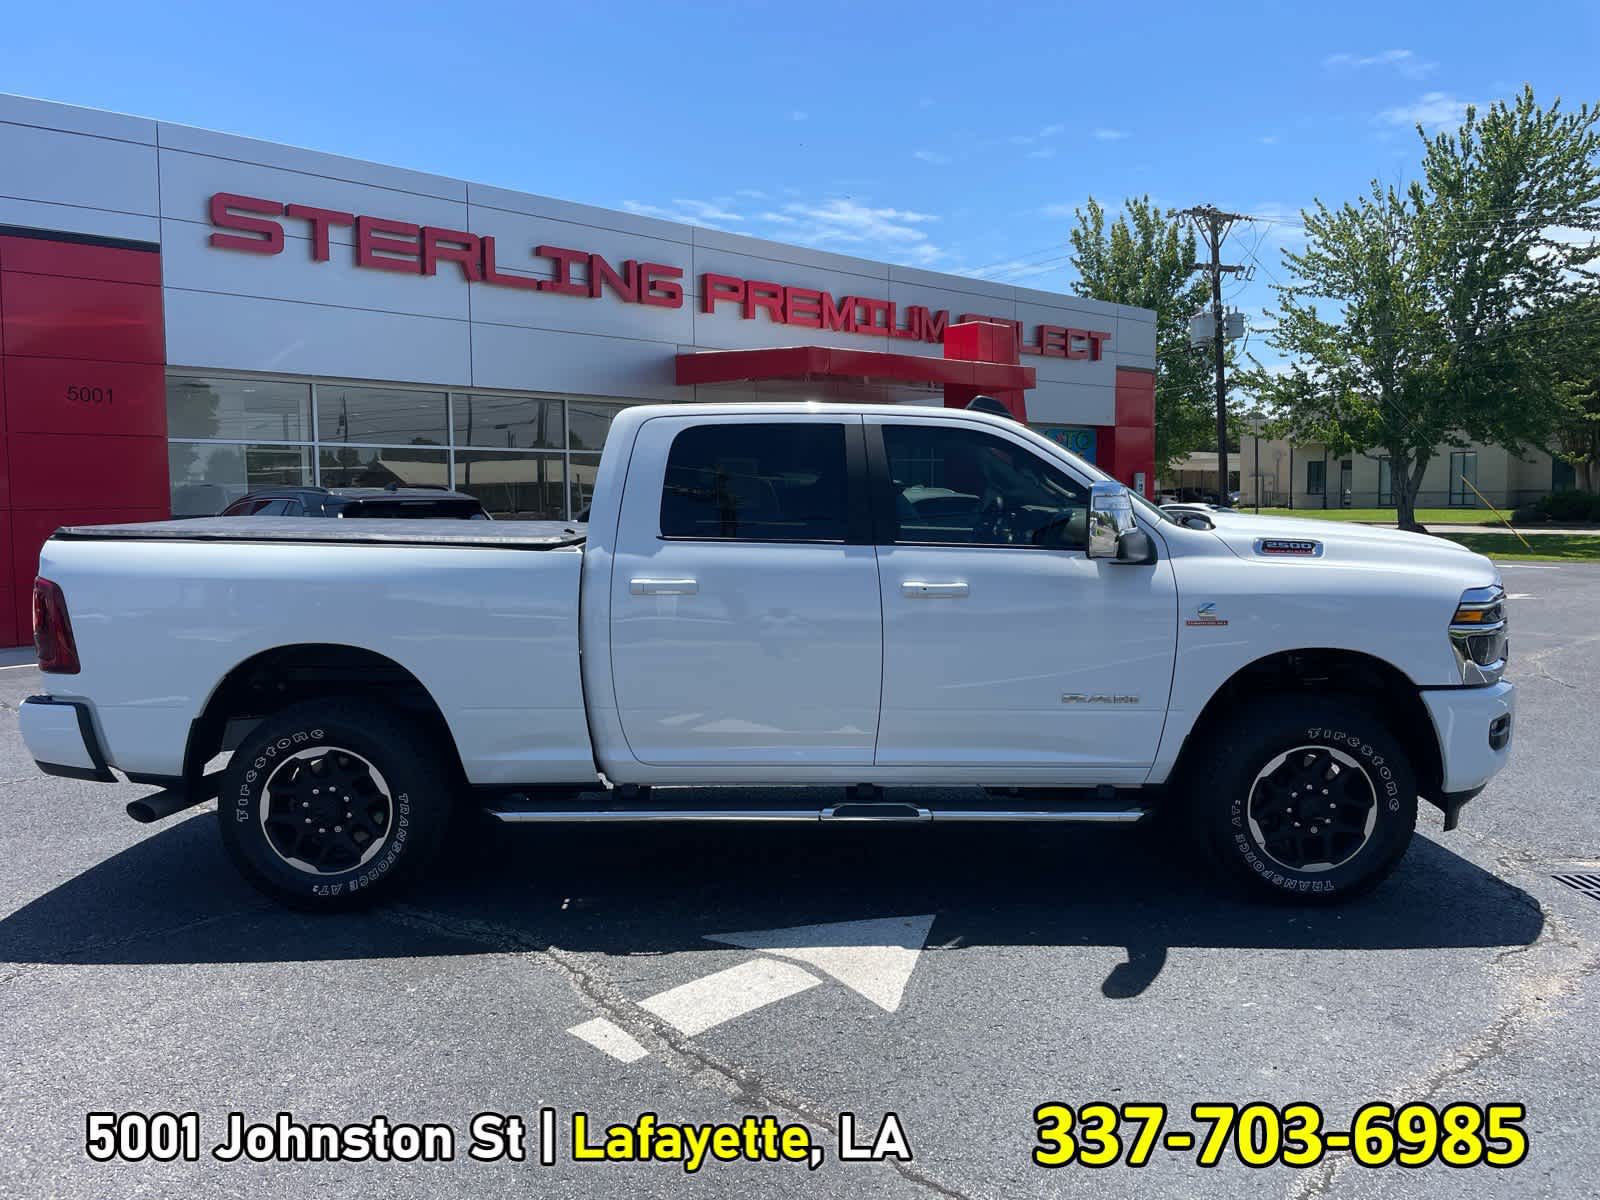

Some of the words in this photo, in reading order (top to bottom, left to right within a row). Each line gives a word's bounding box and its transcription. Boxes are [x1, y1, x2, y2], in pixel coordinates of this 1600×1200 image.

[210, 192, 684, 309] STERLING
[702, 272, 949, 344] PREMIUM
[960, 313, 1111, 361] LECT
[66, 385, 113, 405] 5001
[349, 793, 409, 892] TRANSFORCE
[1234, 833, 1336, 892] TRANSFORCE
